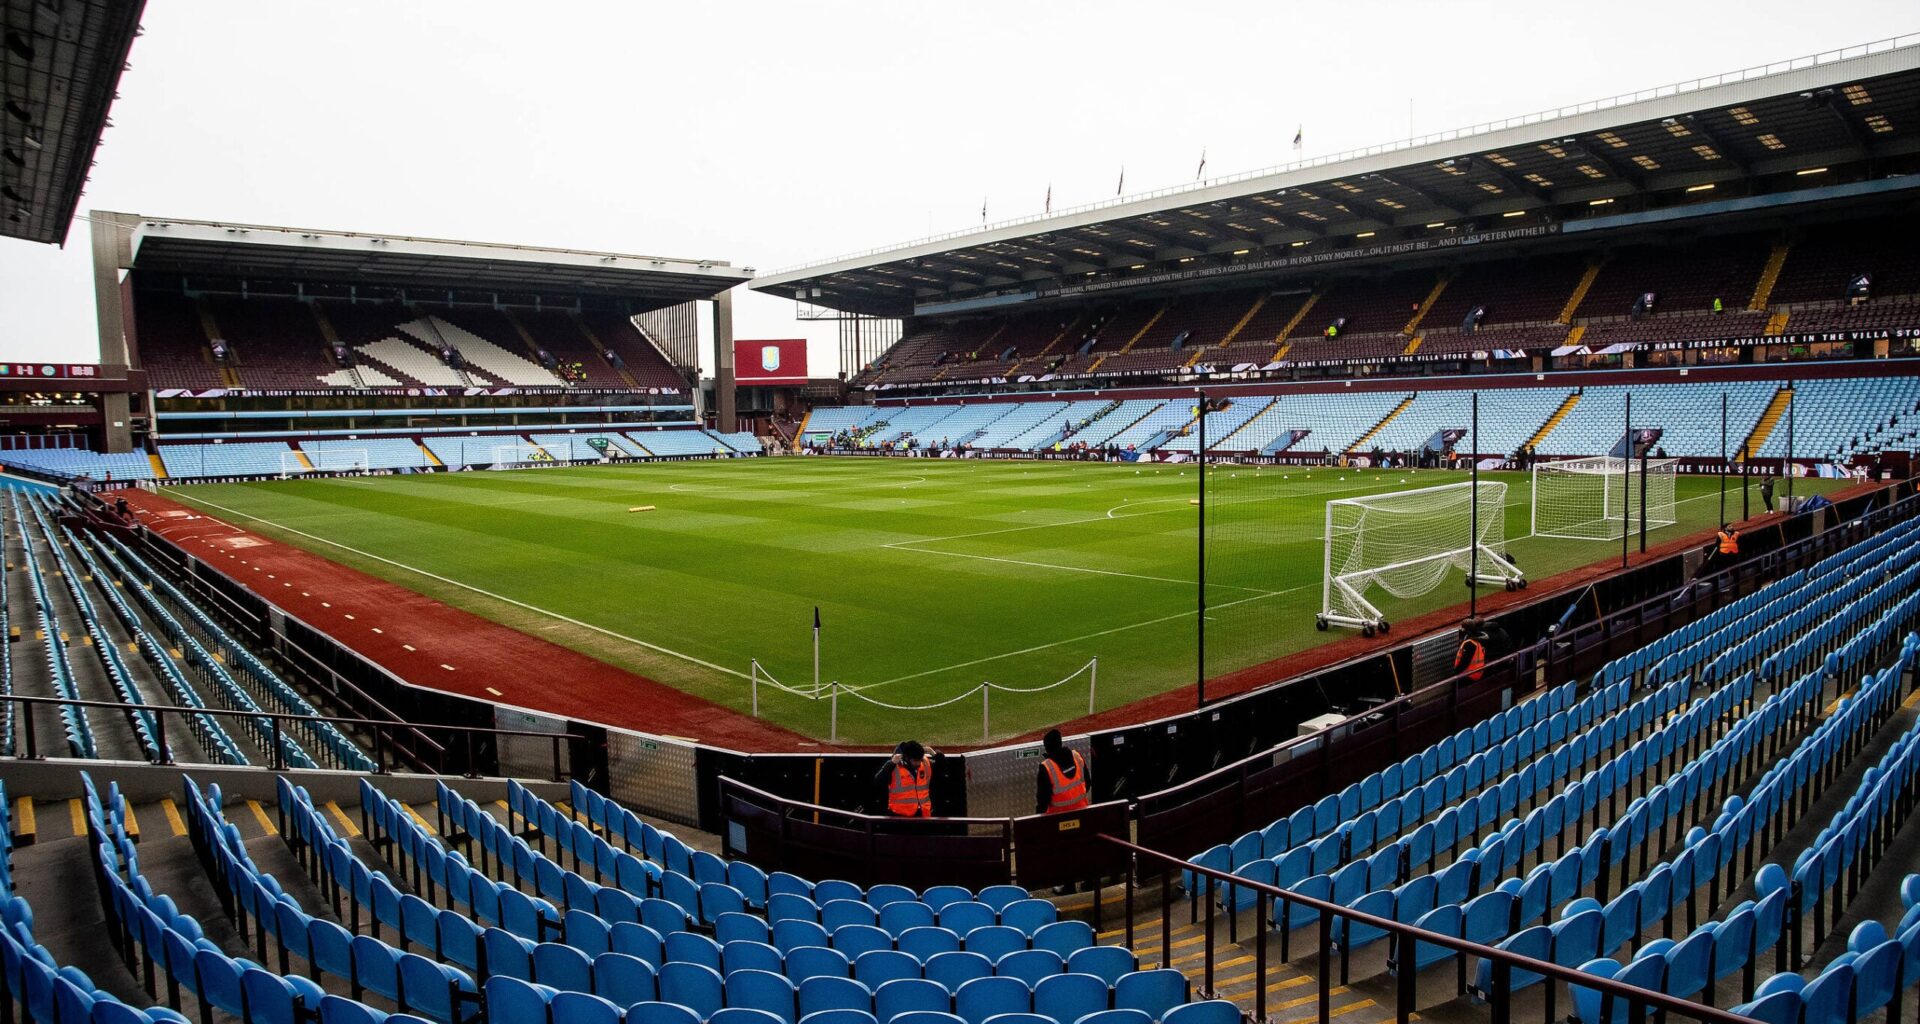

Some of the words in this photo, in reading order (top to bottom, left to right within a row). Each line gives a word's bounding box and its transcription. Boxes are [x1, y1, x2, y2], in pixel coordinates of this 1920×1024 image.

[1085, 282, 1111, 292] PREPARED
[1119, 277, 1151, 287] ADVENTURE
[1152, 275, 1171, 283] DOWN
[1171, 272, 1182, 280] THE
[1199, 267, 1222, 276] THERE'S
[1228, 264, 1246, 272] GOOD
[1248, 262, 1263, 270] BALL
[1264, 259, 1288, 268] PLAYED
[1290, 257, 1298, 265] IN
[1299, 256, 1312, 264] FOR
[1314, 253, 1334, 262] TONY
[1384, 246, 1391, 254] IT
[1392, 243, 1414, 252] MUST
[1438, 238, 1456, 247] AND
[1480, 231, 1507, 241] PETER
[1508, 227, 1538, 238] WITHE
[1688, 339, 1728, 348] JERSEY
[1733, 336, 1796, 346] AVAILABLE
[1803, 334, 1815, 342] IN
[1822, 333, 1845, 341] THE
[1852, 330, 1888, 339] VILLA
[1216, 456, 1238, 464] JERSE
[1279, 456, 1287, 464] IN
[1672, 464, 1692, 473] THE
[1698, 465, 1731, 473] VILLA
